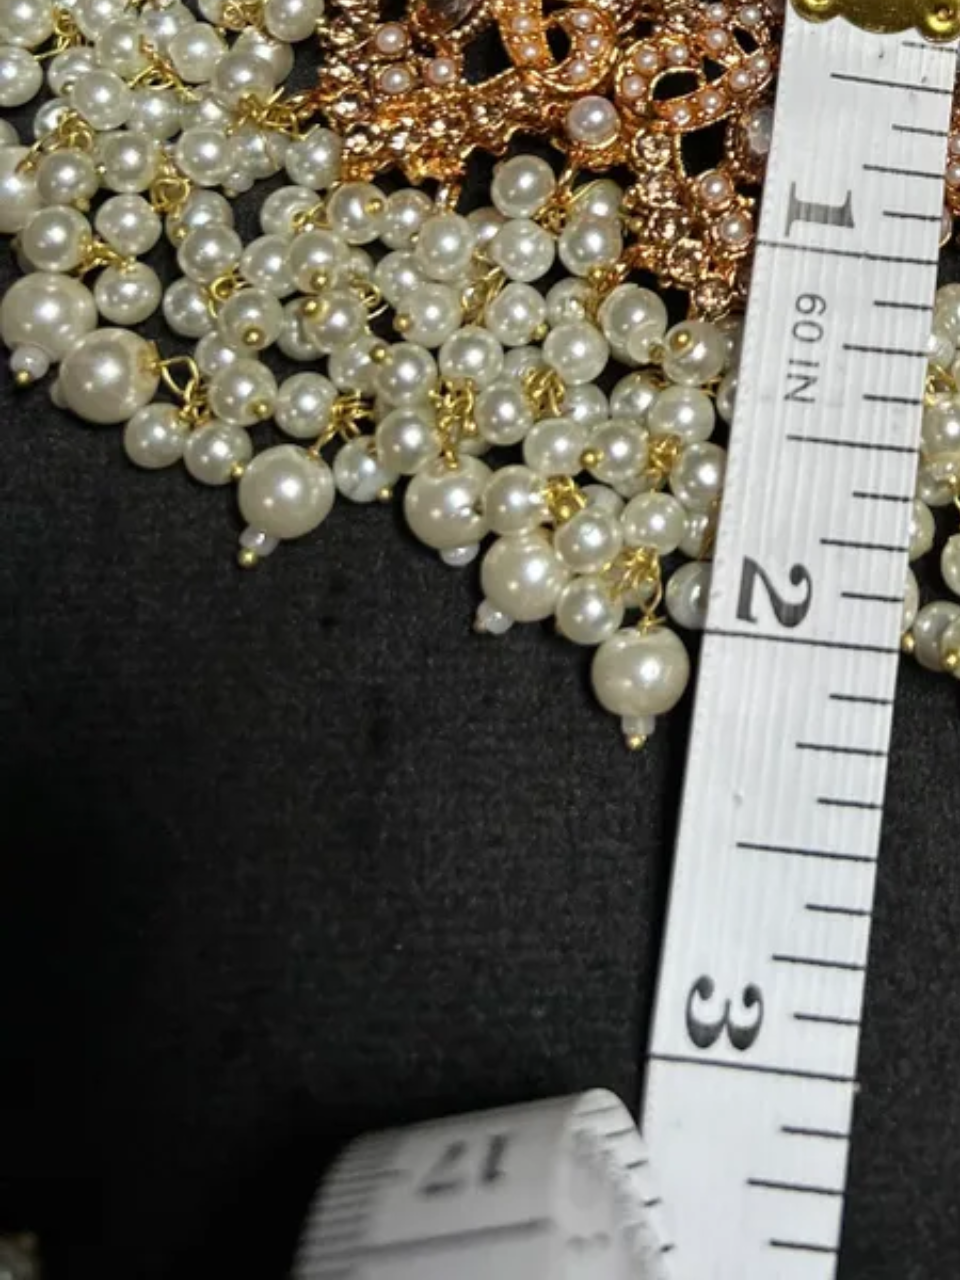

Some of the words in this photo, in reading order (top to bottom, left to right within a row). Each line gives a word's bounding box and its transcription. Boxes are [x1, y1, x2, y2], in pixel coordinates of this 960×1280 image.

[784, 181, 856, 238] 1
[791, 292, 828, 344] 60
[735, 556, 813, 629] 2
[685, 974, 764, 1051] 3
